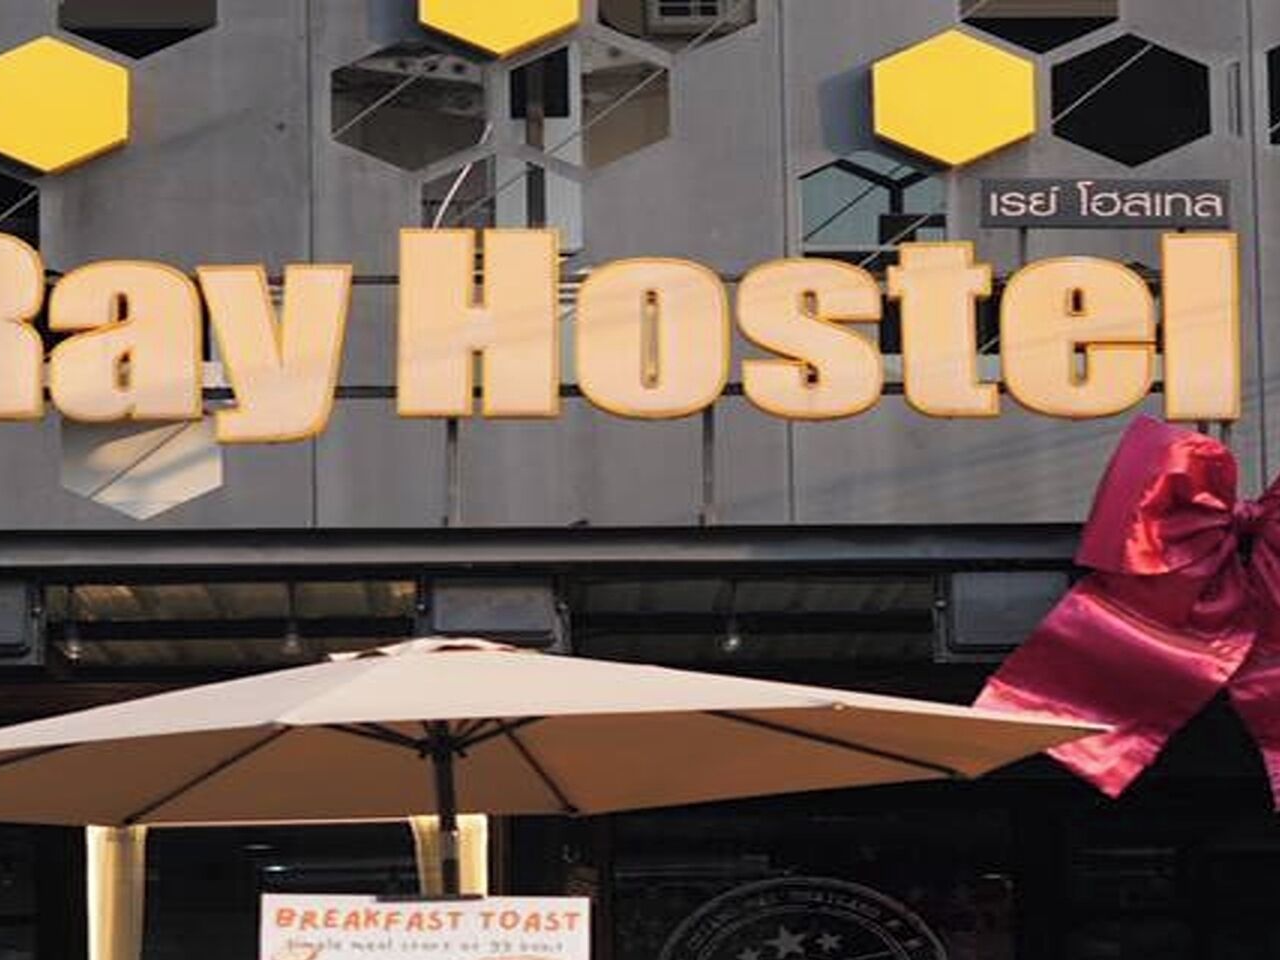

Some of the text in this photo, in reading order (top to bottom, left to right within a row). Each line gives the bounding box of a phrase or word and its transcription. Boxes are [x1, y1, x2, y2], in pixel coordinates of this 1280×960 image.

[989, 181, 1224, 217] เรย์ โฮสเทล
[397, 227, 1242, 421] Hostel
[275, 907, 581, 931] BREAKFAST TOAST
